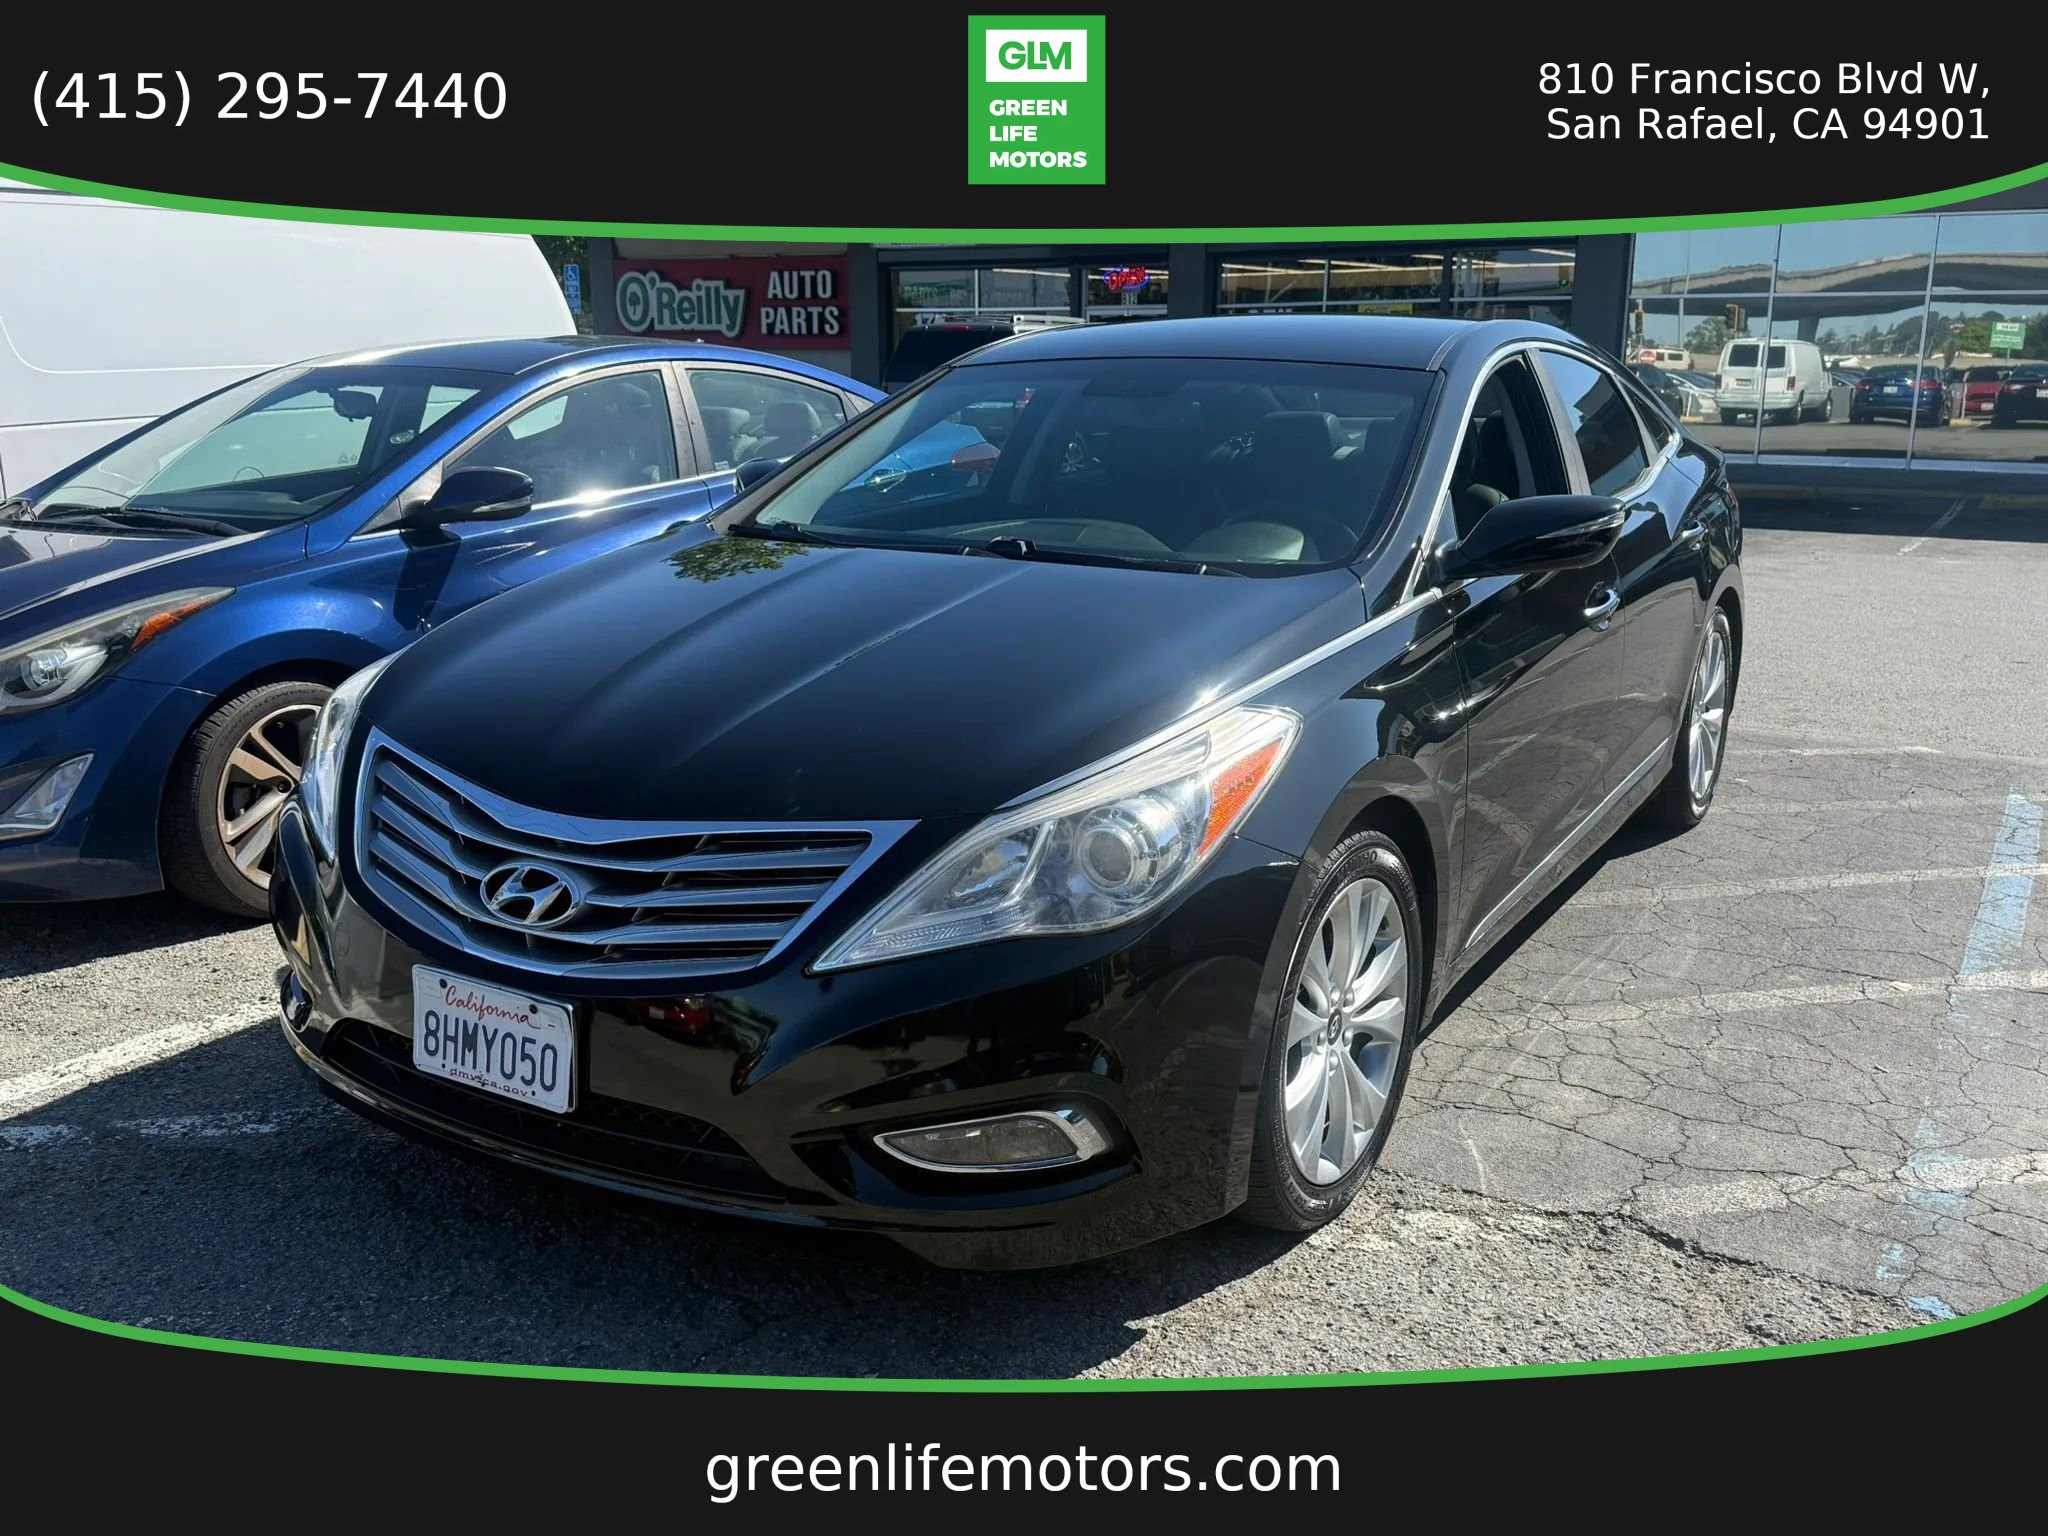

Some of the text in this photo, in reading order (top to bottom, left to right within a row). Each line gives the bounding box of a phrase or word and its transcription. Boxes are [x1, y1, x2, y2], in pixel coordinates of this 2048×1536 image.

[767, 269, 832, 299] AUTO
[1107, 267, 1146, 291] OPEN
[616, 271, 746, 338] O'Reilly
[760, 305, 840, 335] PARTS
[445, 984, 541, 1029] California
[423, 1009, 558, 1092] 8HMY050
[450, 1067, 529, 1097] dmvca.gov
